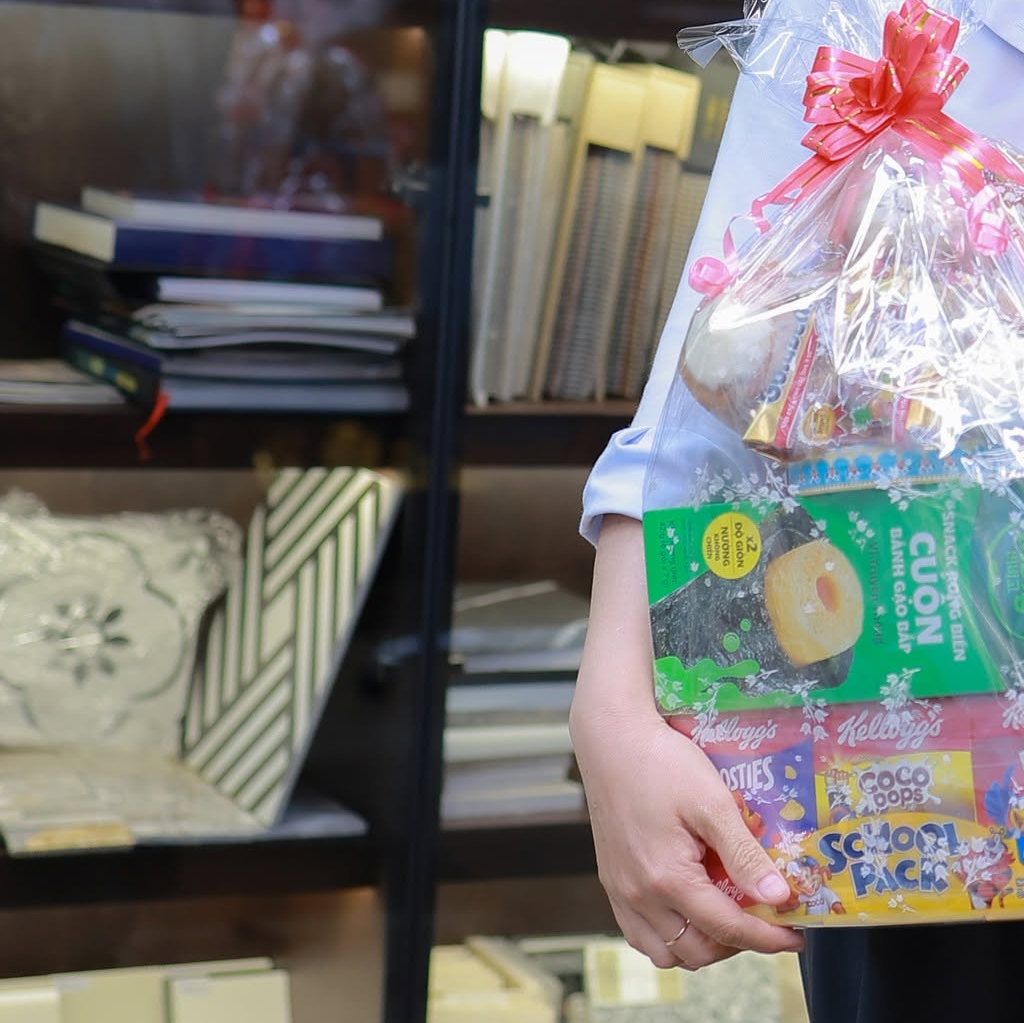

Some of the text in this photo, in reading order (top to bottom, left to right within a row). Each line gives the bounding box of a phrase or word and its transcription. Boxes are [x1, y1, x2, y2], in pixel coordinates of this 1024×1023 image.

[746, 535, 758, 553] x2
[942, 512, 958, 565] SNACK
[891, 581, 908, 617] GẠO
[908, 532, 947, 645] CUỘN
[837, 710, 944, 750] Kellogg's
[720, 756, 775, 792] OSTIES
[859, 766, 930, 794] COCO
[818, 821, 962, 875] SCHOOL
[850, 856, 949, 899] PACK
